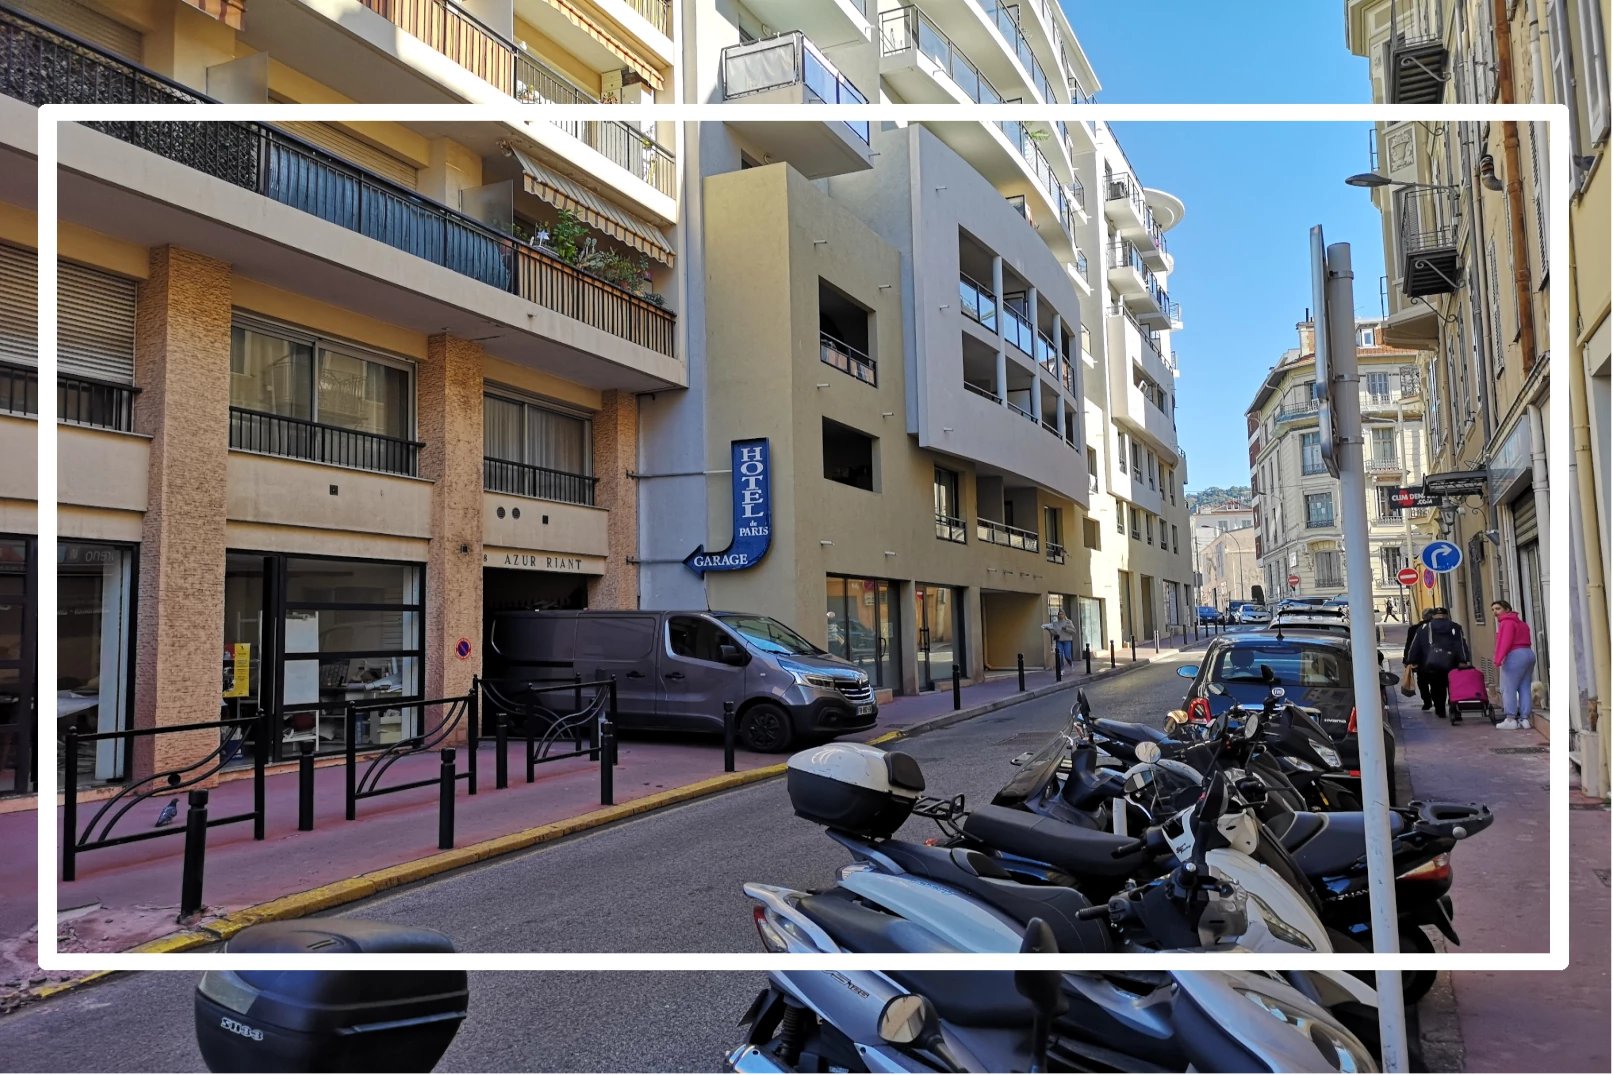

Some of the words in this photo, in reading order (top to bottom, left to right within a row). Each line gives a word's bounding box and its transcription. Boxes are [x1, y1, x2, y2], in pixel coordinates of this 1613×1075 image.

[740, 446, 764, 518] HOTEL
[1391, 494, 1409, 502] CLIM
[739, 526, 769, 537] PARIS
[504, 553, 536, 567] AZUR
[546, 556, 582, 570] RIANT
[693, 553, 749, 567] GARAGE
